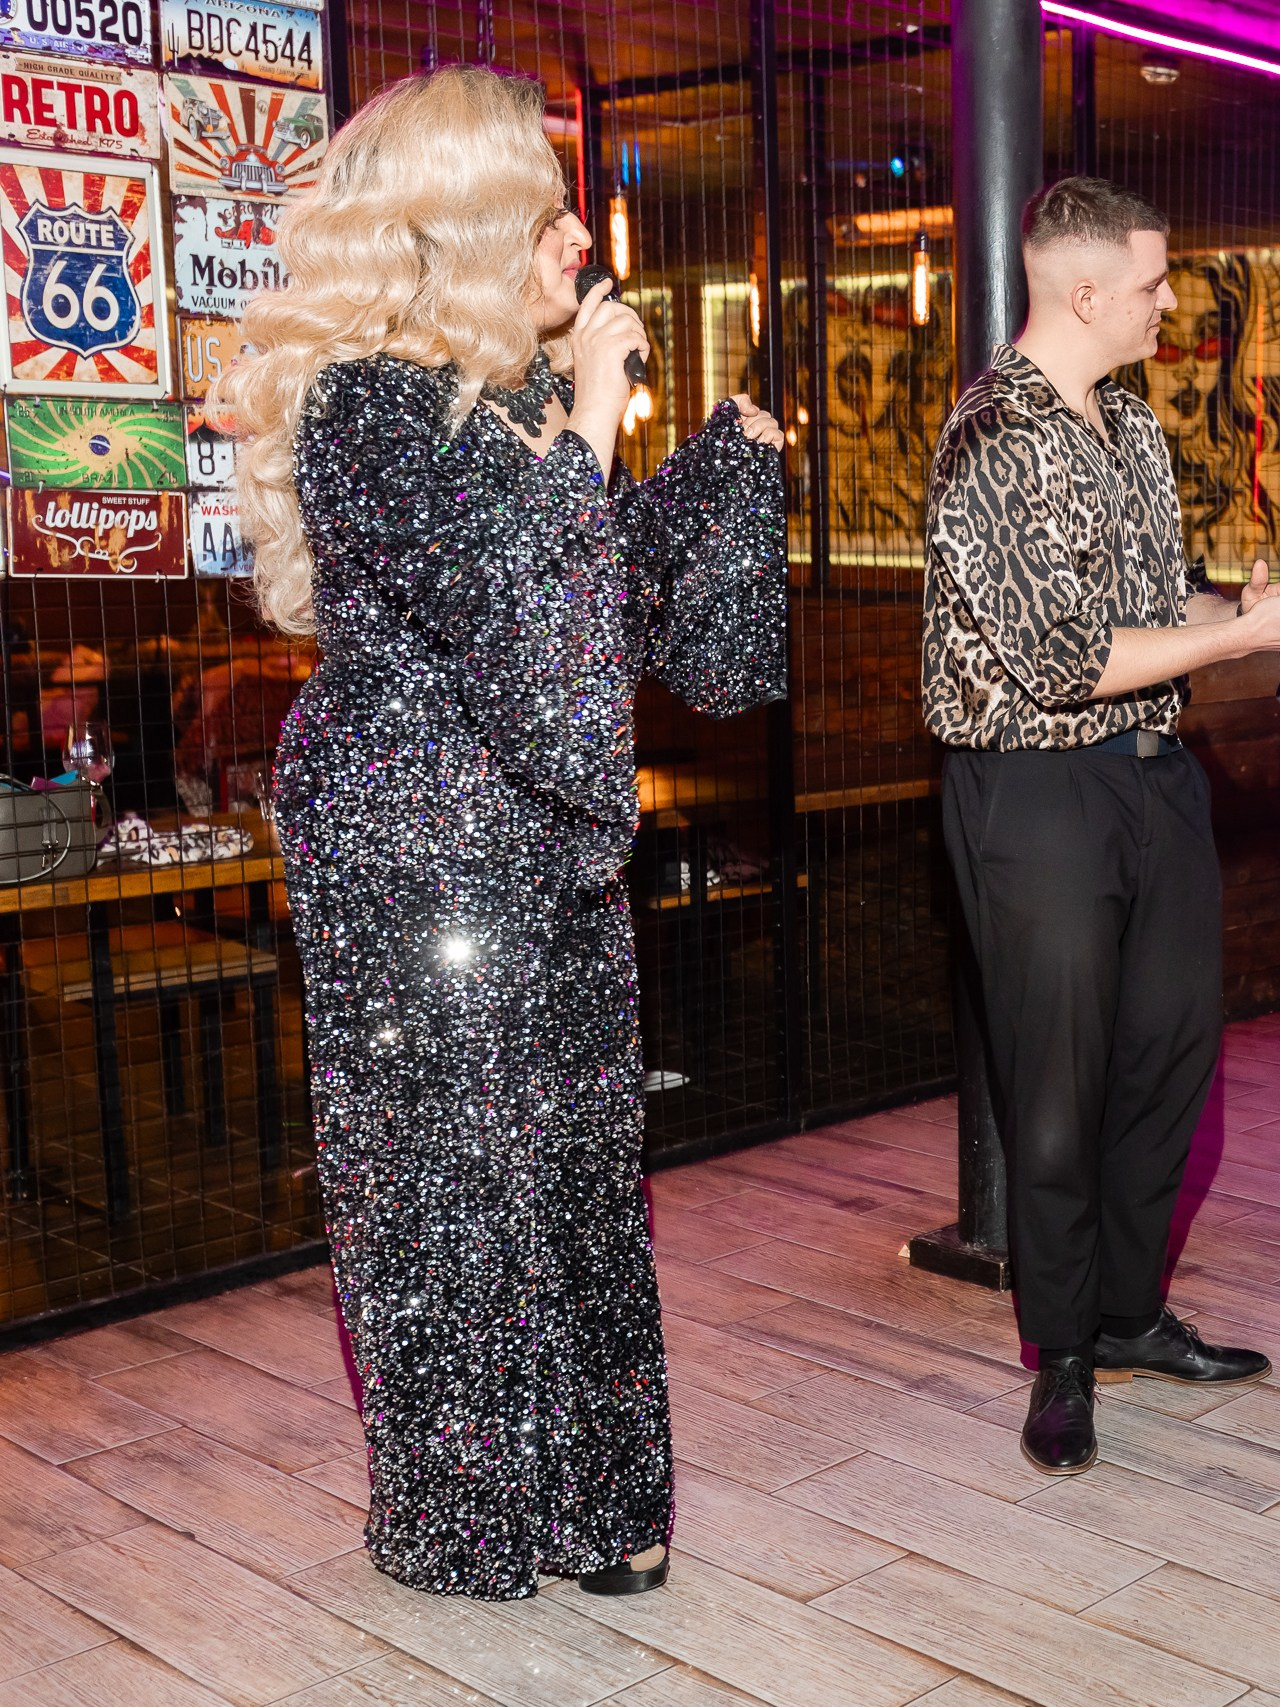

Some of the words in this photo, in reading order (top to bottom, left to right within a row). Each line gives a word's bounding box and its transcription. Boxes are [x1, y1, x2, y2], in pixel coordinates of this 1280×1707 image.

[187, 9, 313, 70] BDC4544
[23, 62, 44, 71] HIGH
[47, 65, 74, 76] GRADE
[1, 73, 139, 138] RETRO
[98, 137, 123, 149] 1975
[37, 219, 115, 247] ROUTE
[43, 260, 120, 332] 66
[191, 295, 236, 310] VACUUM
[186, 335, 222, 383] US
[81, 473, 123, 485] BRAZIL
[102, 496, 126, 505] SWEET
[128, 497, 150, 506] STUFF
